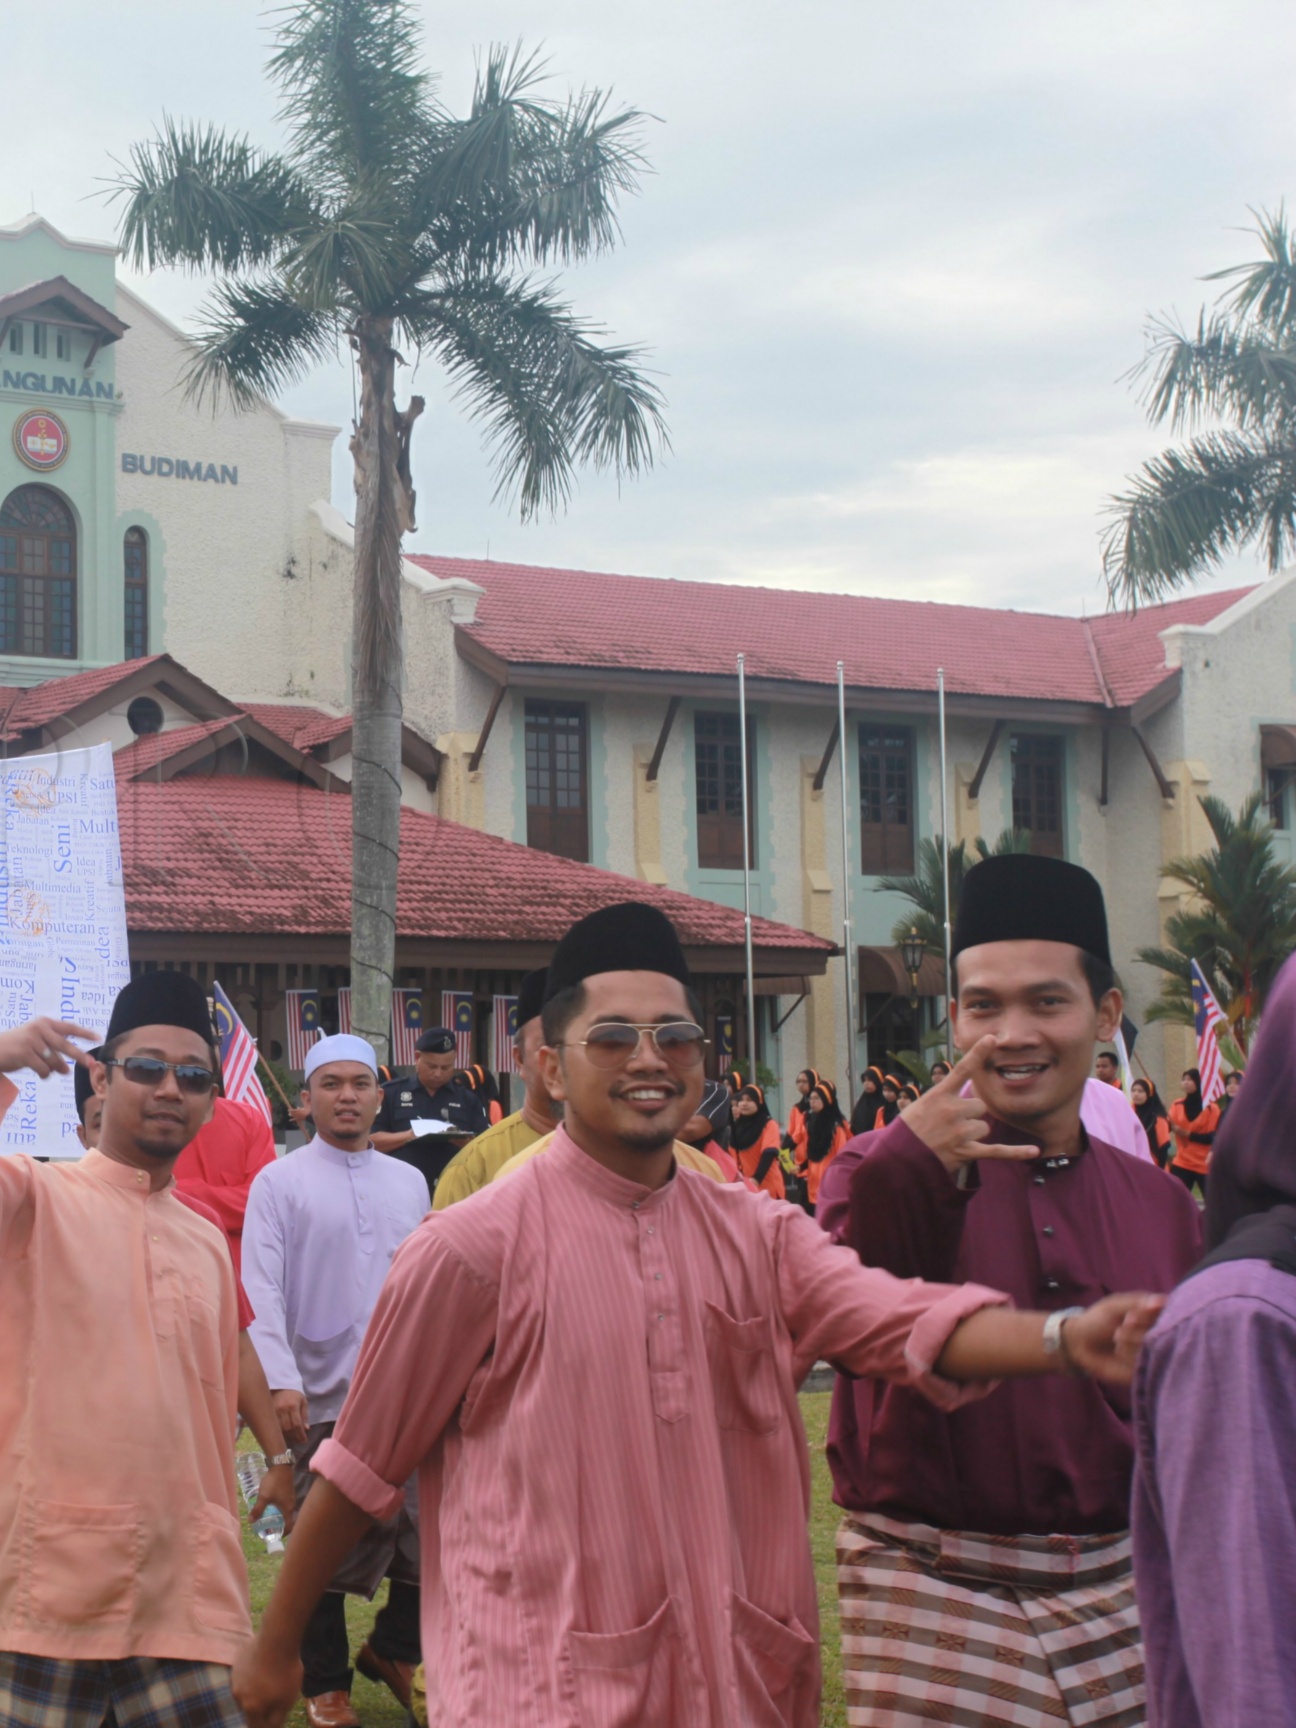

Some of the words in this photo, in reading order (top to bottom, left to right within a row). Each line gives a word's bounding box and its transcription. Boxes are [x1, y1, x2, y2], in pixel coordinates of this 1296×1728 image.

[121, 453, 239, 486] BUDIMAN
[7, 843, 54, 858] Teknologi
[54, 823, 73, 874] Seni
[25, 878, 81, 895] Multimedia
[20, 1079, 37, 1132] Reka
